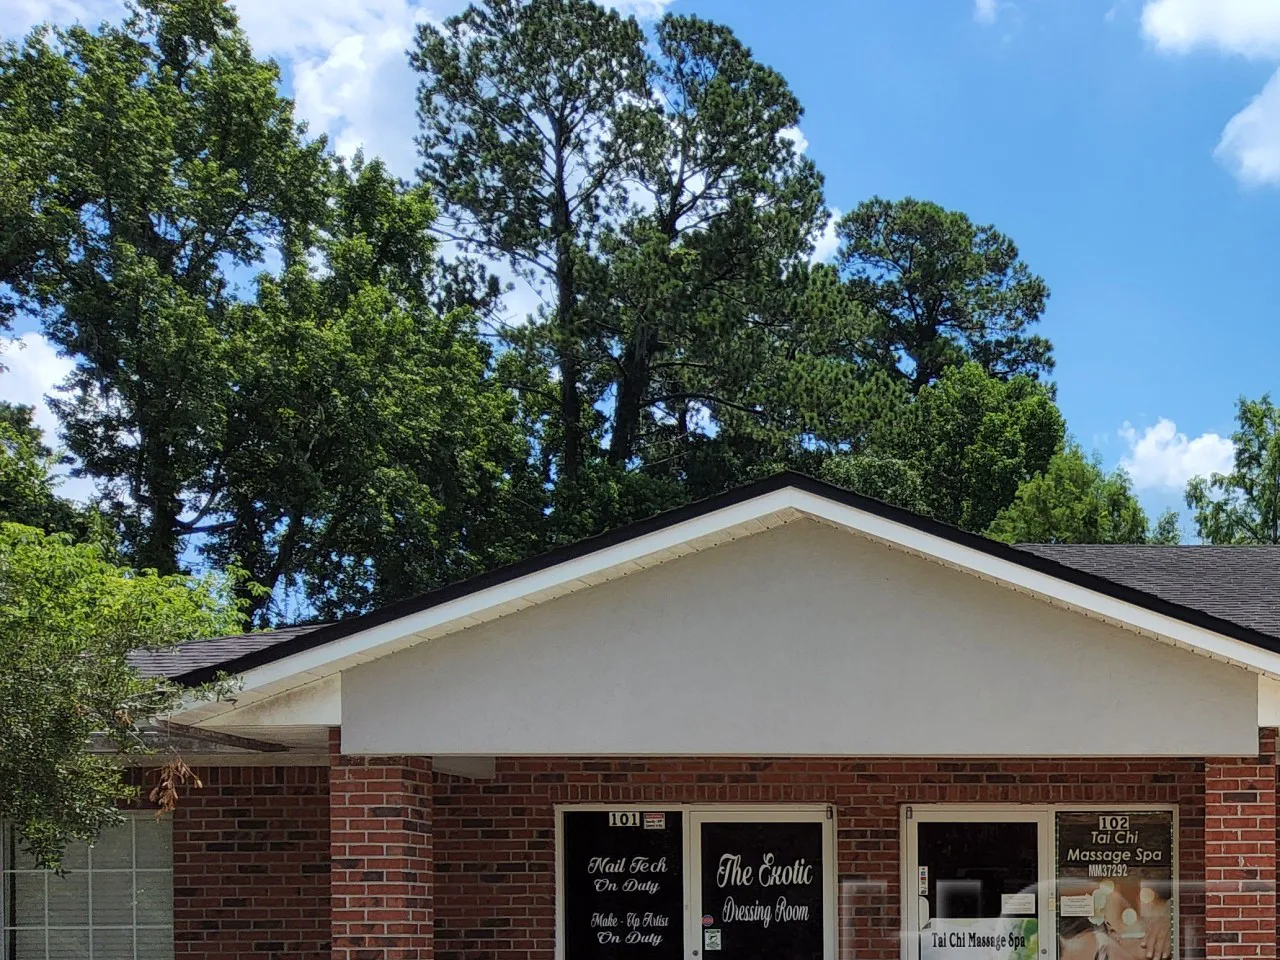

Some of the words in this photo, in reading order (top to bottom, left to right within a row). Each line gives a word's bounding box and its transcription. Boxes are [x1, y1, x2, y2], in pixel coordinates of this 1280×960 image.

[611, 813, 638, 826] 101
[1101, 817, 1128, 830] 102
[1091, 831, 1111, 844] Tai
[1114, 831, 1139, 844] Chi
[1067, 848, 1131, 864] Massage
[1135, 847, 1162, 864] Spa
[587, 856, 626, 874] Nail
[629, 856, 668, 874] Tech
[716, 853, 754, 888] The
[758, 852, 813, 888] Exotic
[1088, 864, 1128, 877] MM37292
[594, 878, 619, 892] On
[622, 878, 661, 895] Duty
[722, 895, 773, 929] Dressing
[775, 895, 810, 923] Room
[590, 912, 619, 928] Make
[626, 911, 641, 931] Up
[643, 911, 670, 928] Artist
[597, 931, 622, 944] On
[625, 931, 663, 947] Duty
[931, 932, 947, 948] Tai
[949, 932, 966, 948] Chi
[968, 932, 1006, 951] Massage
[1008, 932, 1026, 951] Spa
